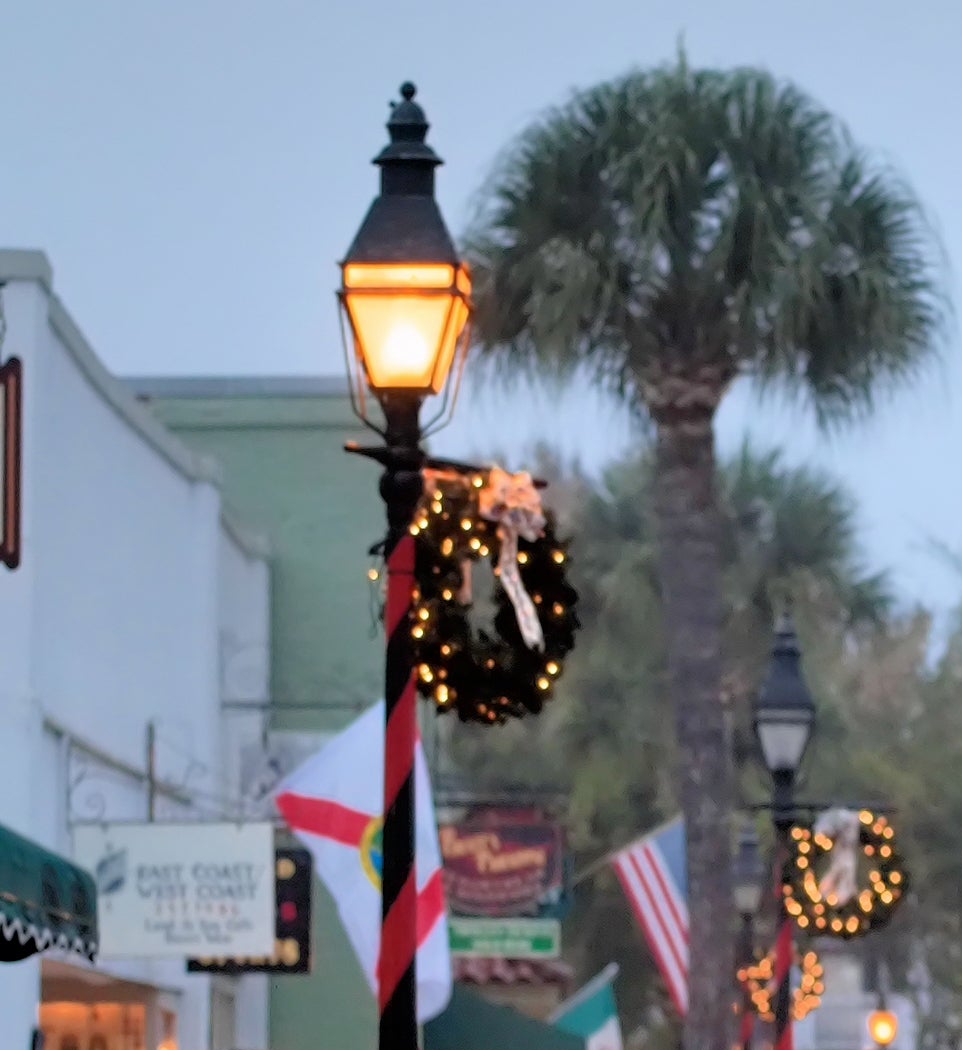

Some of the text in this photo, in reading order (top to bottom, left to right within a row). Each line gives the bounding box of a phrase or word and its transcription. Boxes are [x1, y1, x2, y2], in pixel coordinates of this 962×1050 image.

[136, 862, 182, 881] EAST
[136, 881, 258, 900] WEST COAST
